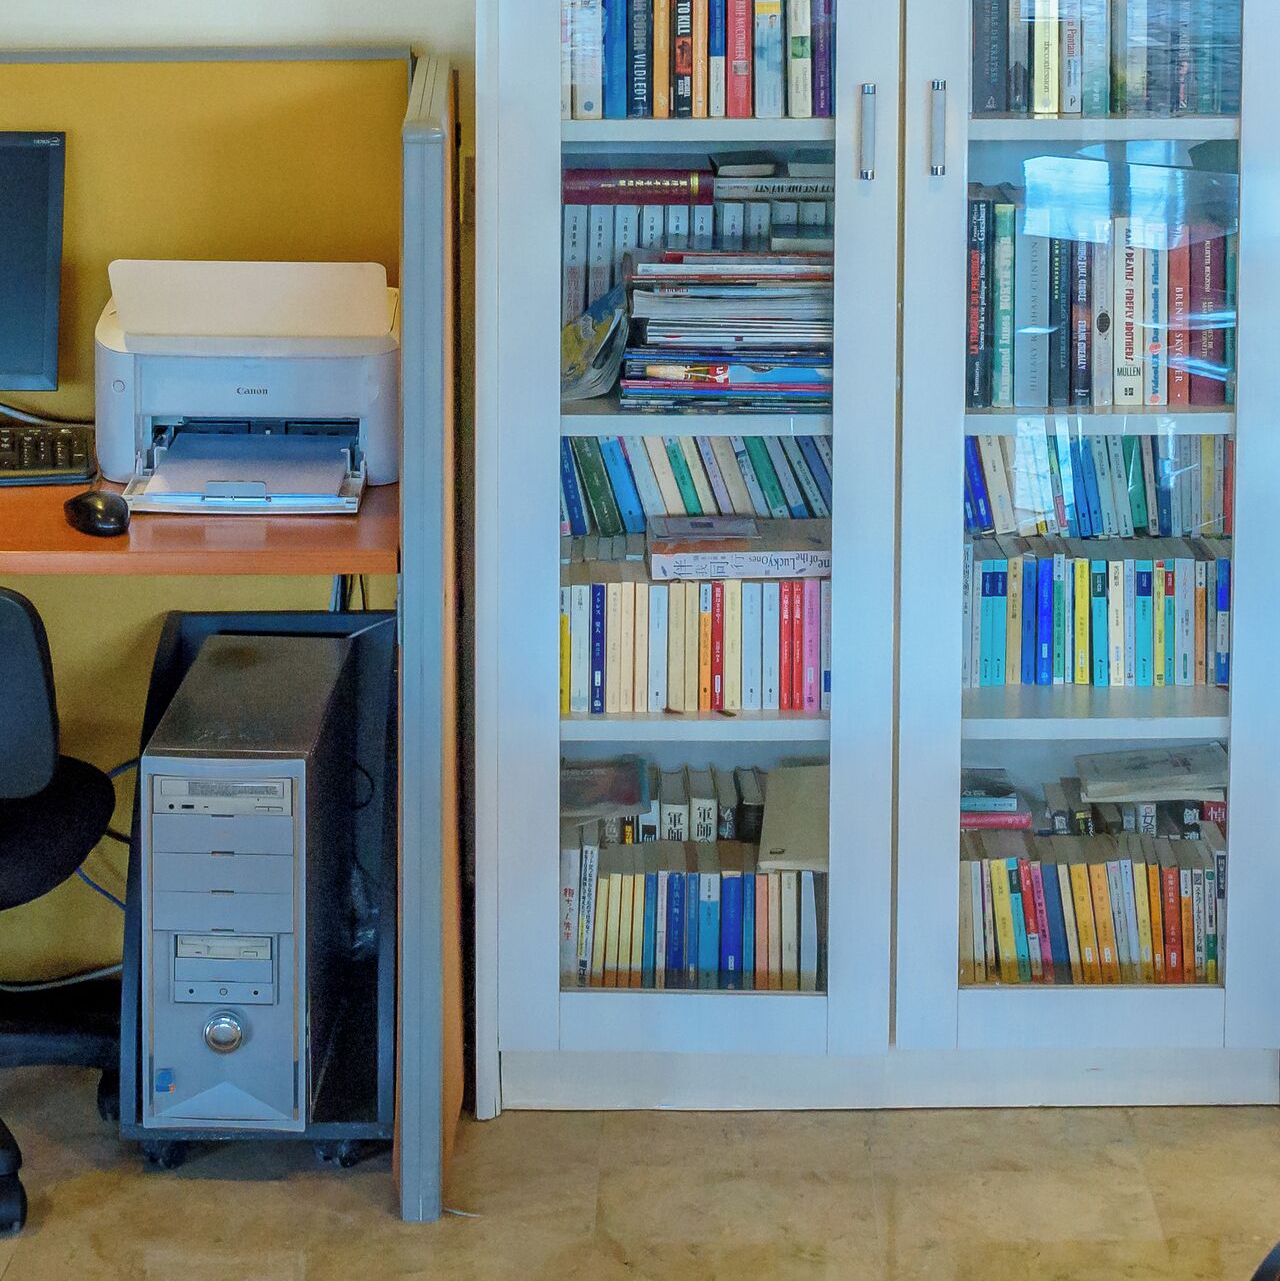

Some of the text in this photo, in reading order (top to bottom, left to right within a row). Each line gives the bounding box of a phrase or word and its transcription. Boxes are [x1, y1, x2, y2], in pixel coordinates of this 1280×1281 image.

[677, 1, 690, 14] TO
[677, 15, 690, 35] KILL
[1066, 28, 1077, 57] Pantani
[977, 204, 986, 242] Giesbert
[1124, 252, 1134, 281] DEATHS
[1077, 279, 1087, 302] CIRCLE
[1030, 242, 1039, 392] HILLARY CLINTON
[1124, 288, 1135, 361] FIREFLY BROTHERS
[999, 315, 1011, 344] Innes
[1117, 367, 1141, 377] MULLEN
[236, 387, 269, 396] Canon
[796, 553, 808, 565] the
[809, 554, 818, 565] of
[818, 559, 830, 569] ne
